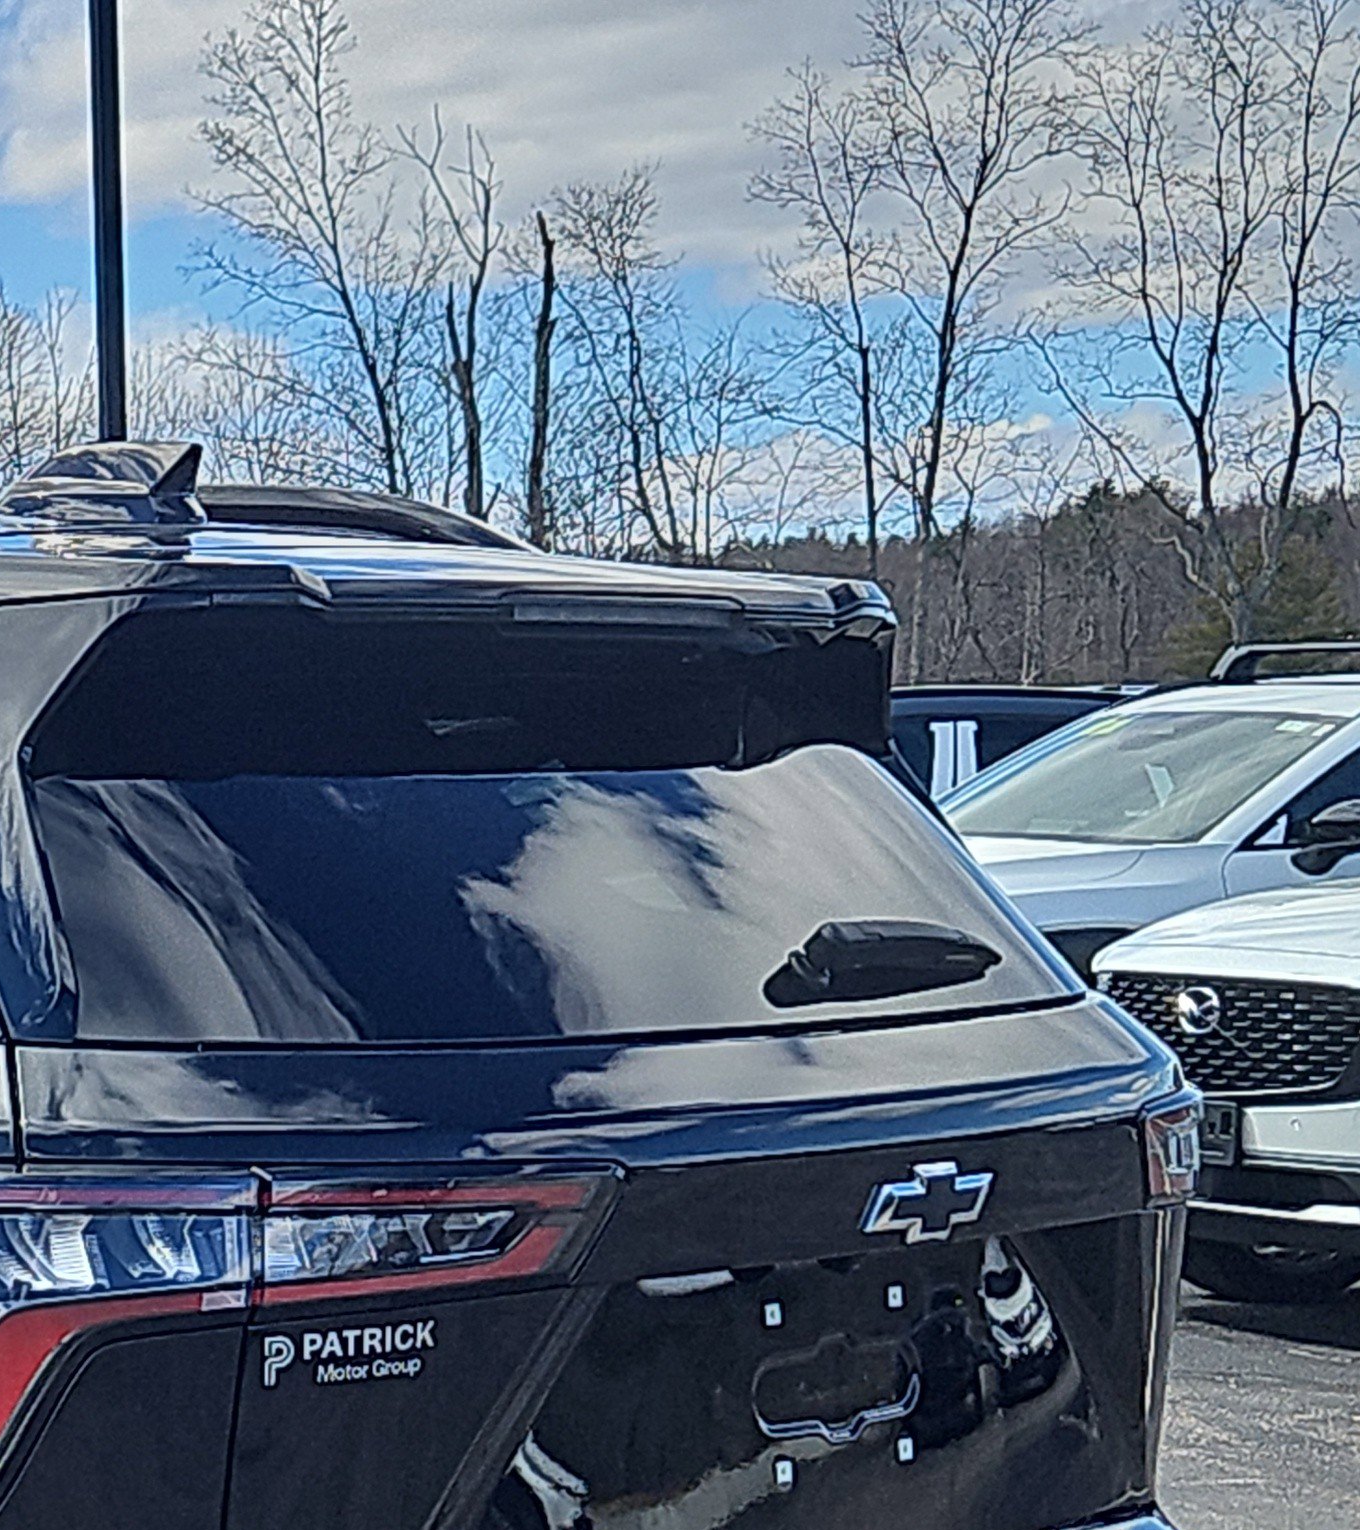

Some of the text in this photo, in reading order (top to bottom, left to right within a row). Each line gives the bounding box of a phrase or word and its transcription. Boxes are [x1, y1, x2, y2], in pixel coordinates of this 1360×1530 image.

[302, 1320, 435, 1361] PATRICK
[316, 1357, 422, 1384] Motor Group
